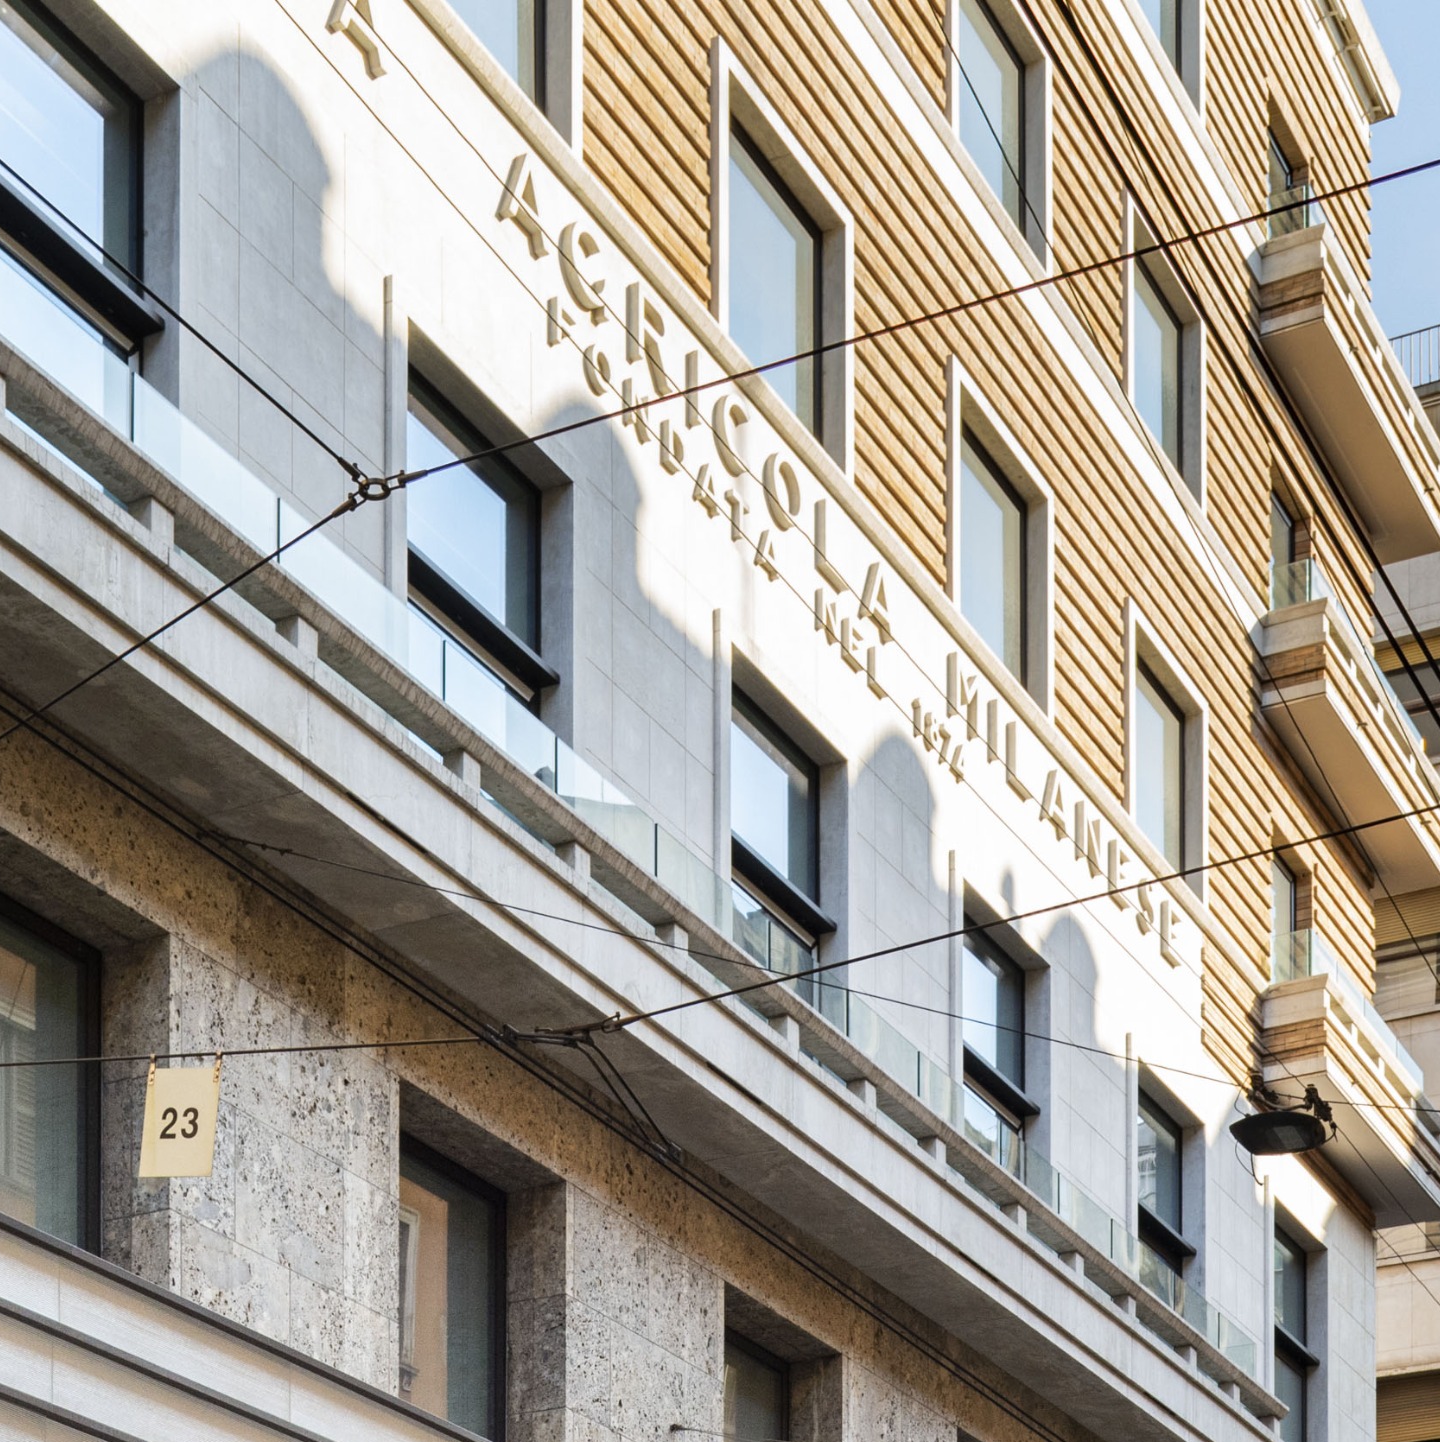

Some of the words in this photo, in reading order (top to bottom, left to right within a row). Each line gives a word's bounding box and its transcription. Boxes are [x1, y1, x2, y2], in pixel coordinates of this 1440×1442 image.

[495, 153, 894, 646] AGRICOLA
[946, 651, 1183, 967] MILANESE
[546, 296, 780, 583] FONDATA
[814, 588, 889, 700] NEL
[159, 1107, 199, 1139] 23
